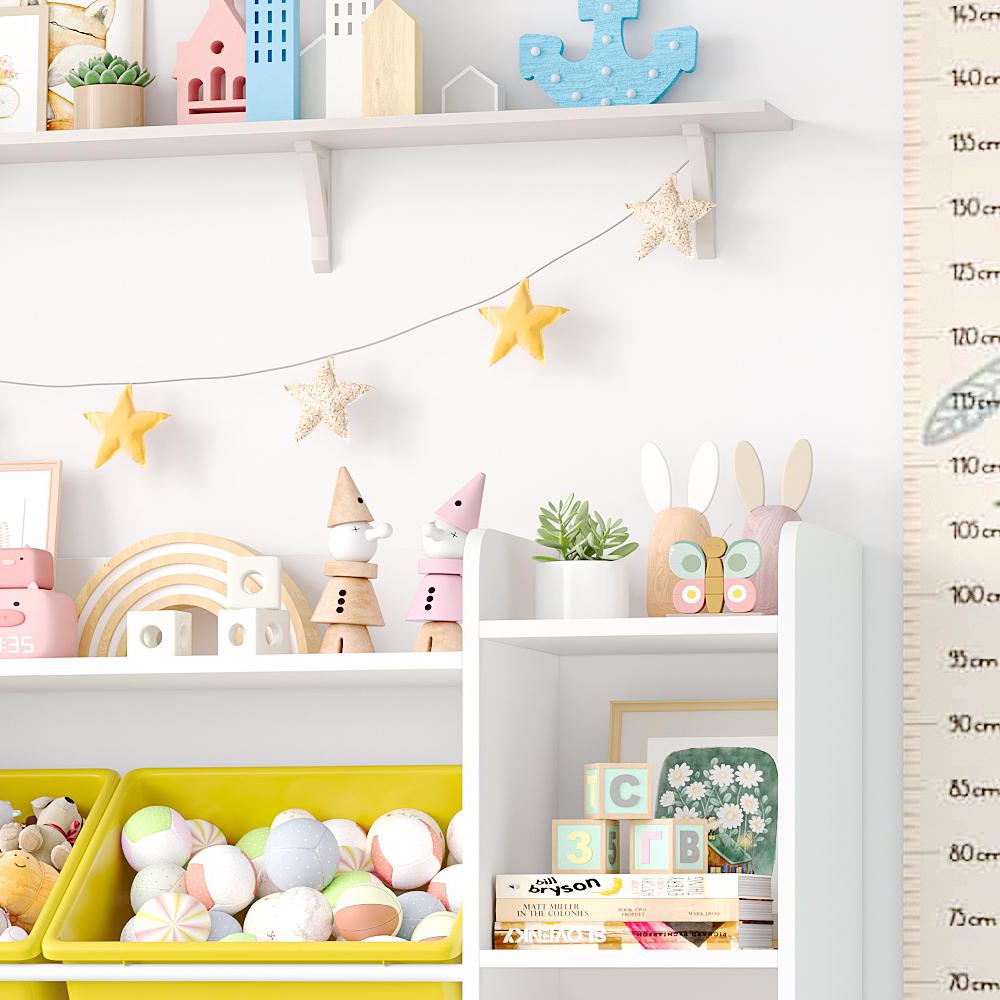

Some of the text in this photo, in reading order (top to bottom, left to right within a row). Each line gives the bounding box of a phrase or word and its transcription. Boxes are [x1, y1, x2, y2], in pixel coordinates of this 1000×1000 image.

[987, 593, 1000, 603] c
[610, 774, 640, 808] C
[568, 831, 593, 864] 3
[680, 831, 700, 863] B
[528, 878, 601, 896] bryson
[535, 876, 557, 885] bill
